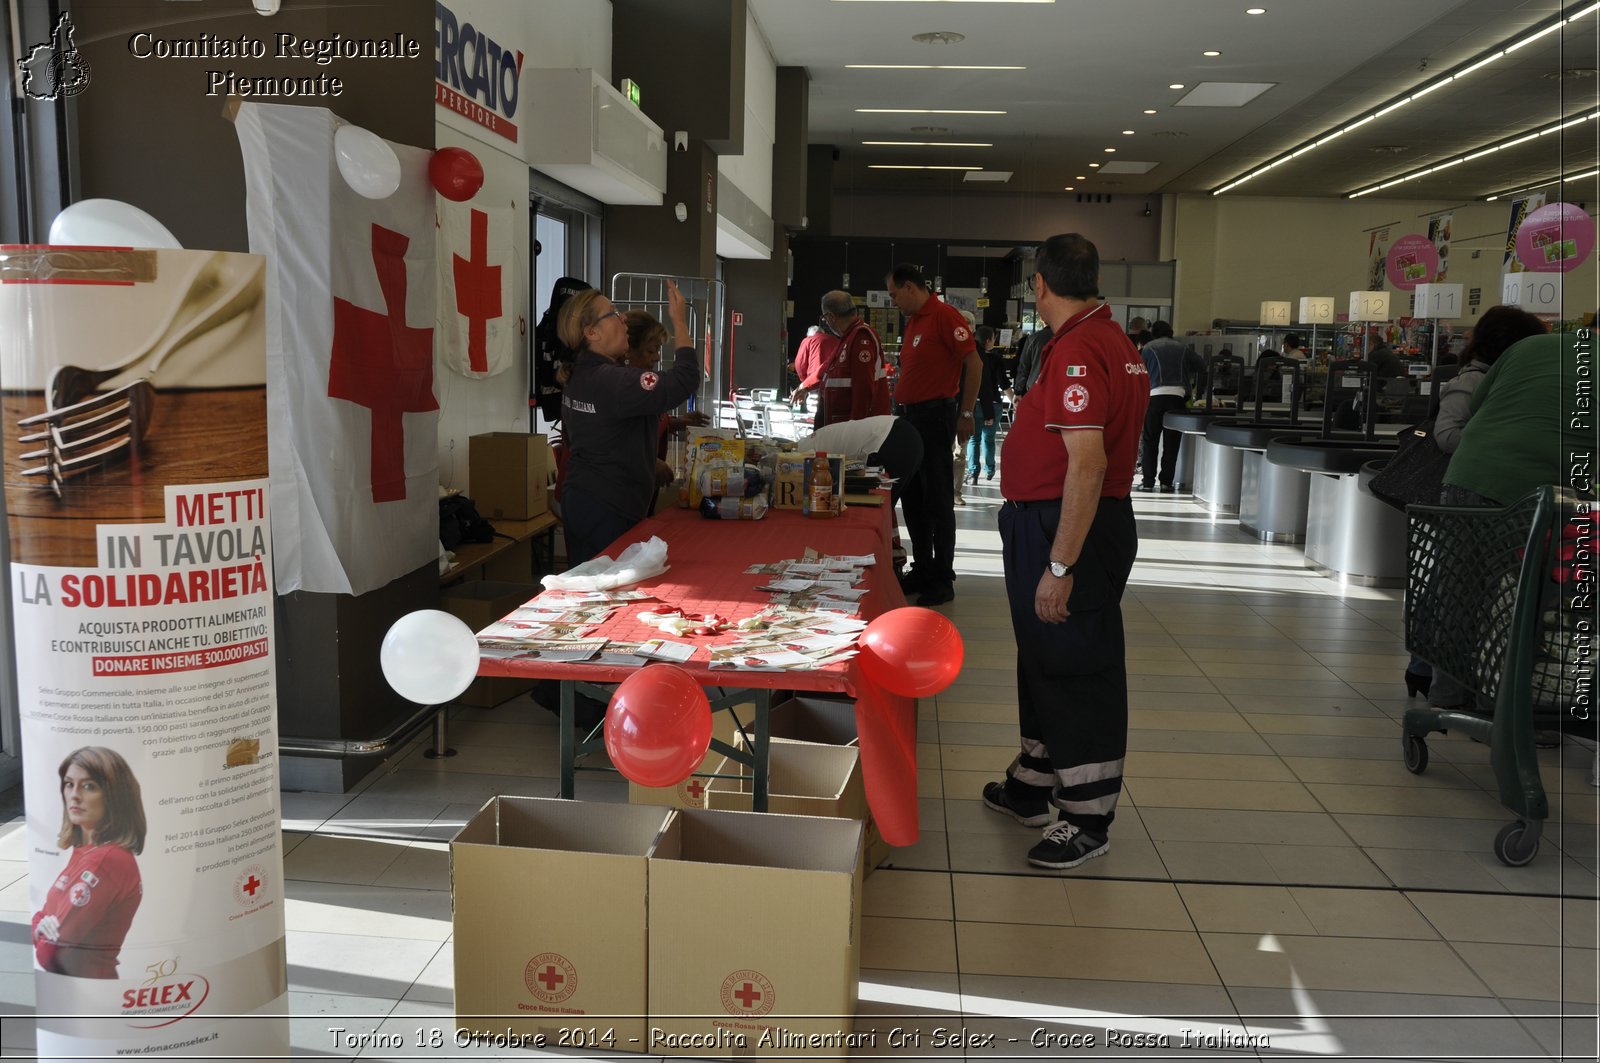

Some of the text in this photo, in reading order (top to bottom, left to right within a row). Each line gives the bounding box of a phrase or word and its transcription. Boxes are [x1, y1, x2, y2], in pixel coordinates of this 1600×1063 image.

[1433, 292, 1455, 310] 11
[1527, 282, 1556, 304] 10
[1270, 307, 1286, 320] 14
[1311, 303, 1330, 318] 13
[1363, 299, 1385, 315] 12
[781, 481, 796, 506] R
[176, 488, 264, 527] METTI
[107, 525, 267, 568] IN TAVOLA
[20, 555, 267, 608] LA SOLIDARIETÀ
[78, 605, 267, 637] ACQUISTA PRODOTTI ALIMENTARI
[51, 624, 268, 654] E CONTRIBUISCI ANCHE TU. OBIETTIVO:
[95, 640, 268, 673] DONARE INSIEME 300.000 PASTI
[81, 689, 134, 697] Commerciale,
[136, 686, 166, 695] insieme
[168, 685, 182, 693] alle
[198, 679, 225, 690] insegne
[234, 669, 269, 683] supermercati
[80, 702, 112, 710] presenti
[122, 701, 141, 709] tutta
[143, 700, 164, 708] Italia,
[174, 694, 212, 705] occasione
[213, 691, 224, 700] del
[236, 681, 270, 694] Anniversario
[72, 714, 93, 722] Rossa
[94, 714, 123, 722] Italiana
[188, 706, 219, 716] benefica
[102, 727, 135, 735] povertà.
[137, 725, 168, 734] 150.000
[169, 722, 188, 732] pasti
[189, 718, 218, 728] saranno
[219, 713, 240, 723] donati
[241, 709, 250, 718] dal
[250, 704, 271, 716] Gruppo
[198, 730, 205, 738] di
[152, 749, 176, 758] grazie
[179, 745, 192, 754] alla
[193, 738, 230, 753] generosità
[210, 776, 231, 786] primo
[158, 796, 194, 806] dell'anno
[217, 782, 250, 796] solidarietà
[180, 807, 194, 815] alla
[195, 802, 223, 812] raccolta
[231, 795, 245, 805] beni
[170, 844, 193, 853] Croce
[194, 840, 215, 849] Rossa
[216, 833, 240, 844] Italiana
[240, 824, 263, 837] 250.000
[180, 830, 198, 839] 2014
[205, 824, 232, 836] Gruppo
[232, 819, 249, 828] Selex
[235, 841, 249, 850] beni
[201, 860, 230, 872] prodotti
[122, 980, 195, 1009] SELEX
[148, 1002, 192, 1015] COMMERCIALE
[518, 1003, 585, 1015] Croce Rossa Italiana
[712, 1020, 733, 1028] Croce
[734, 1022, 756, 1030] Rossa
[116, 1031, 219, 1055] www.donaconselex.it
